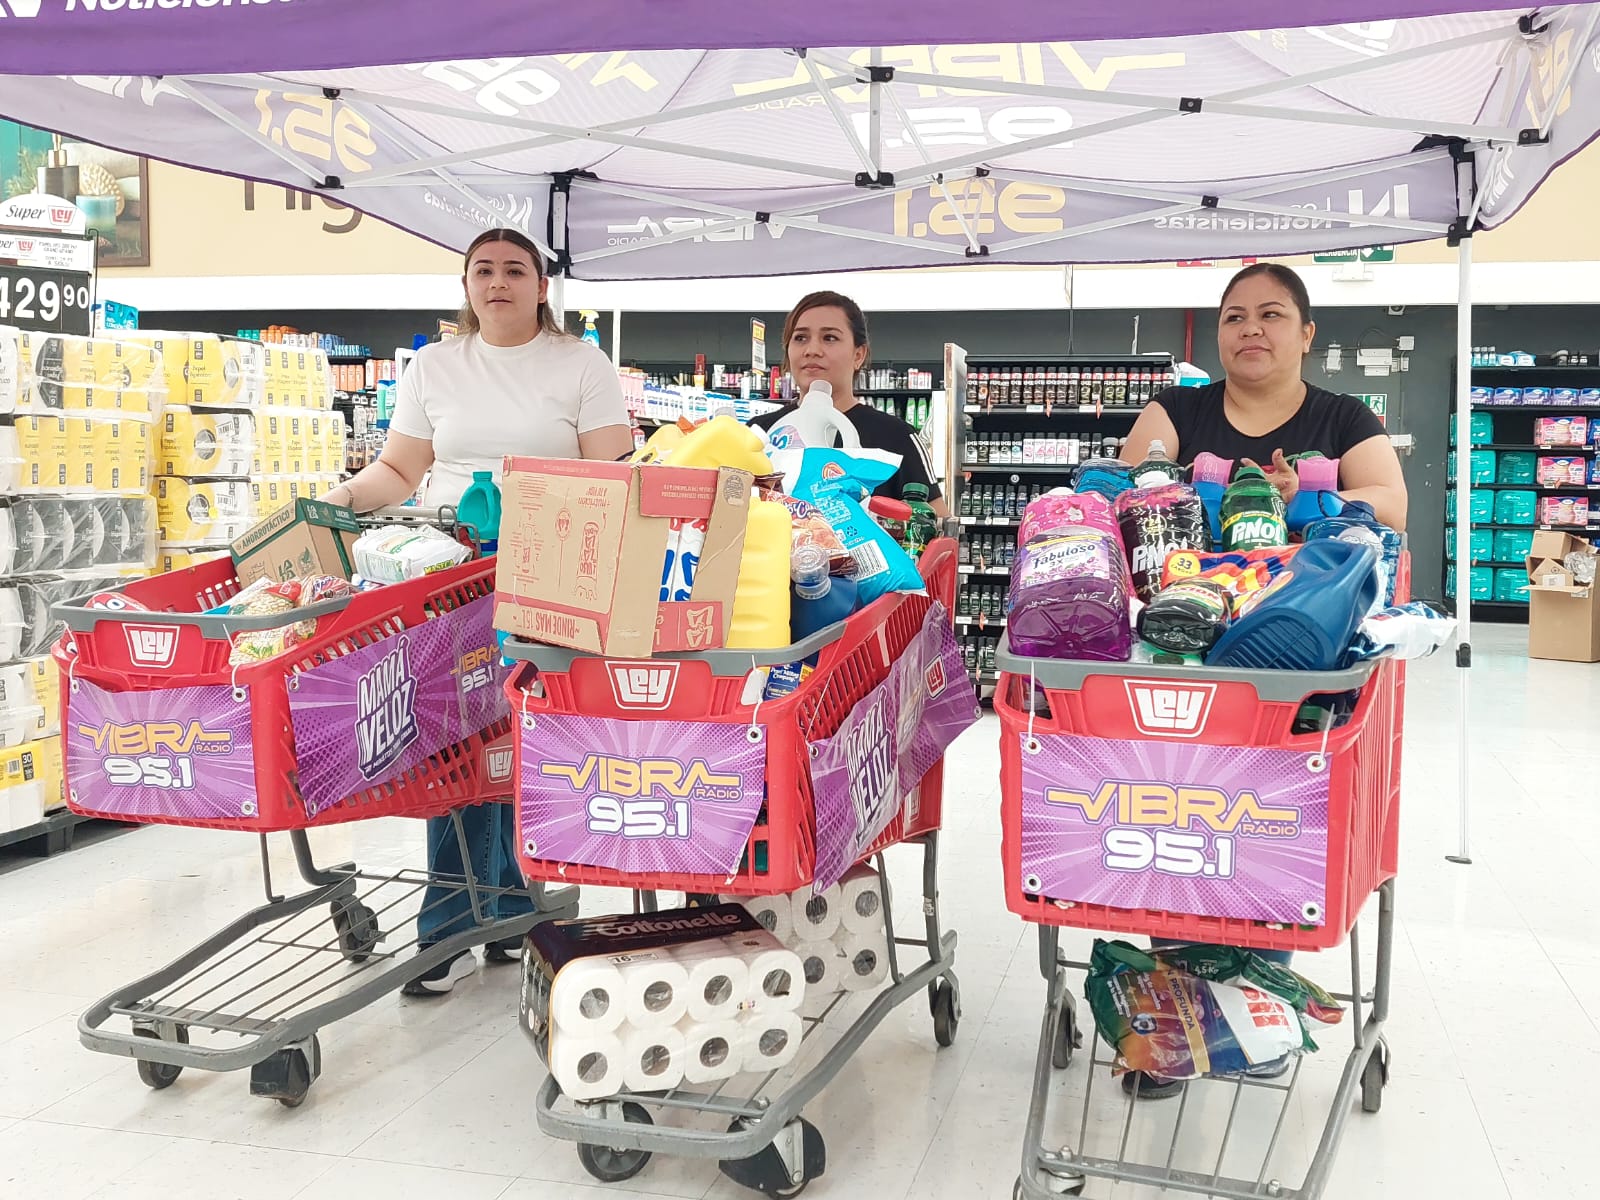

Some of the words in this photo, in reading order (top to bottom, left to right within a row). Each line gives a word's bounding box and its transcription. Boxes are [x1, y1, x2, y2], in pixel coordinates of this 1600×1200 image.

[6, 204, 45, 220] Super
[63, 284, 89, 309] 90
[242, 509, 290, 549] AHORROTÁCTICO
[1177, 558, 1192, 570] 33
[552, 614, 576, 639] RINDE
[361, 636, 409, 719] MAMÁ
[462, 669, 496, 694] 95.1
[361, 682, 412, 764] VELOZ
[78, 721, 230, 754] VIBRA
[196, 744, 231, 752] RADIO
[22, 754, 32, 764] 30
[104, 757, 193, 788] 95.1
[542, 756, 740, 797] VIBRA
[696, 788, 740, 799] RADIO
[1048, 783, 1296, 832] VIBRA
[589, 797, 688, 836] 95.1
[1242, 822, 1297, 836] RADIO
[1104, 828, 1232, 876] 95.1
[600, 912, 742, 937] Cottonelle
[1170, 978, 1196, 1031] PROFUNDA
